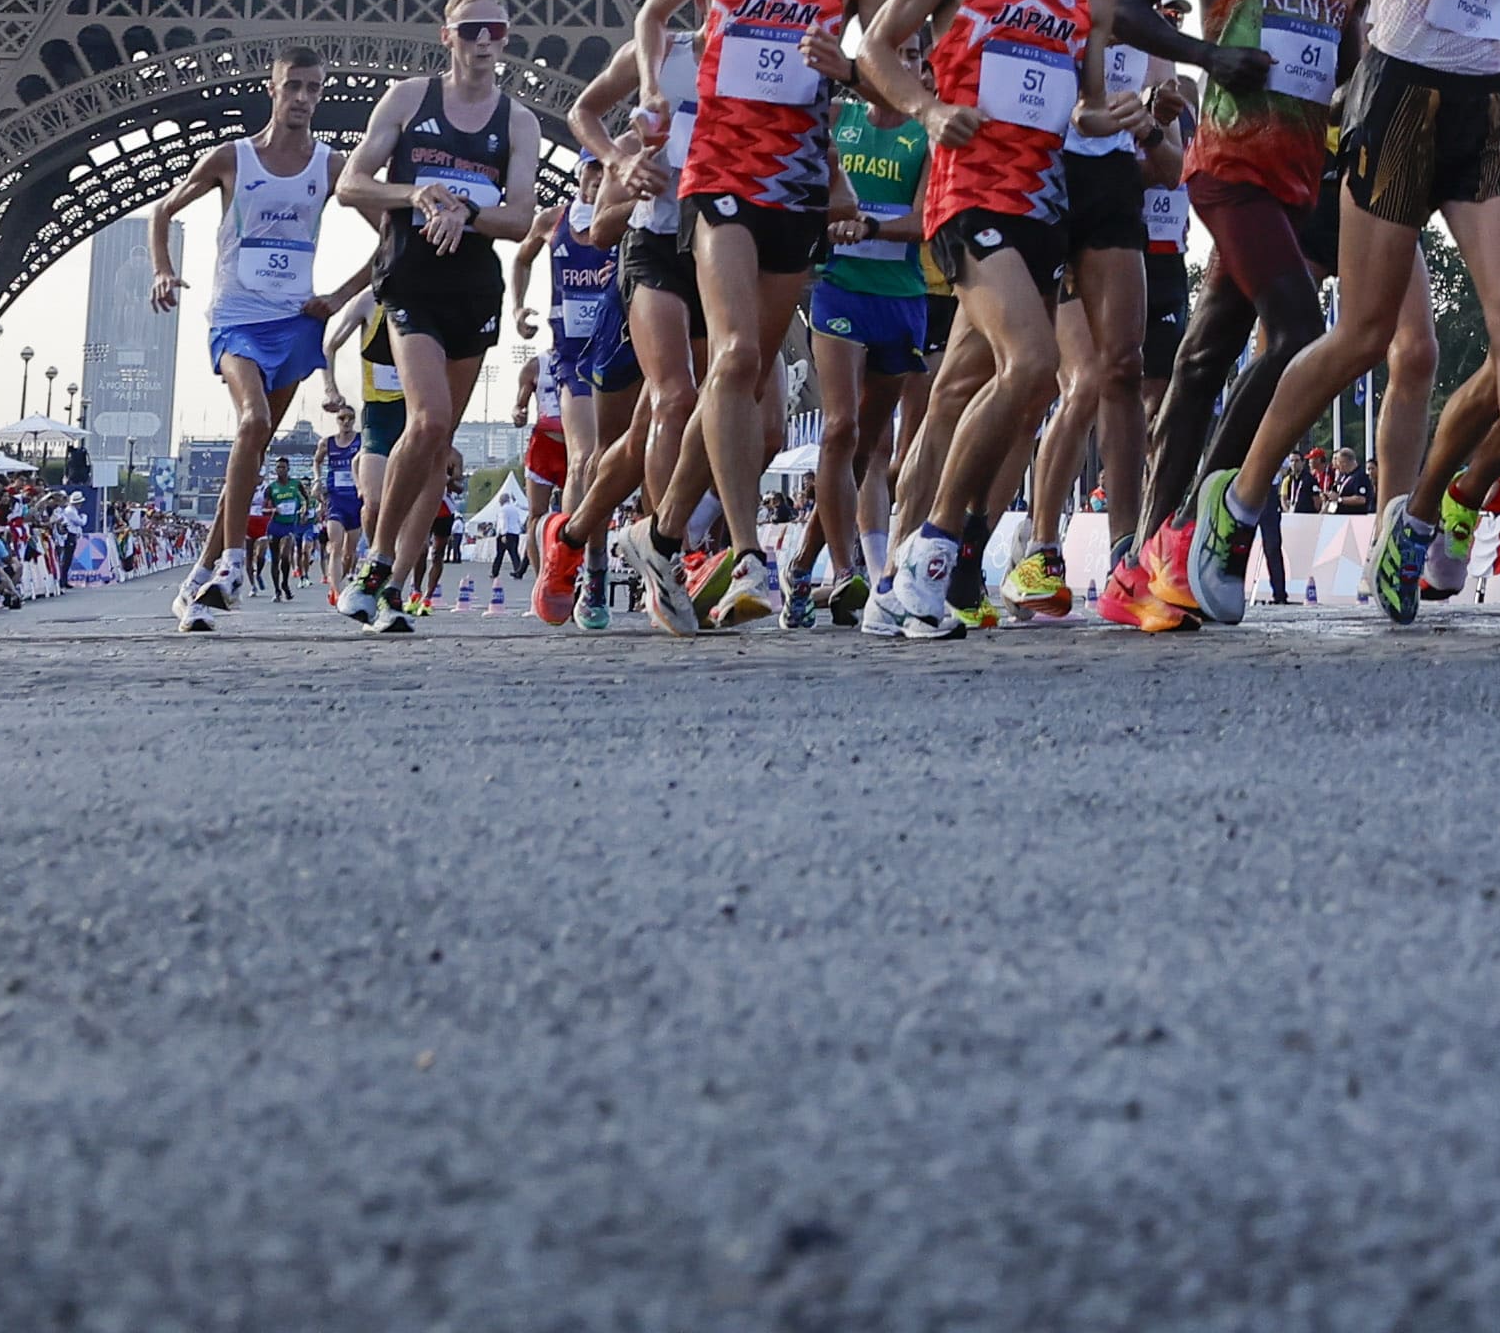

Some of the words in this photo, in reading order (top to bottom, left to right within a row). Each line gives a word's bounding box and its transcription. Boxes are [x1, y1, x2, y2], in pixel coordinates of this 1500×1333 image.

[990, 3, 1076, 41] JAPAN
[758, 47, 786, 70] 59
[1301, 44, 1322, 68] 61
[1022, 68, 1046, 94] 57
[842, 153, 903, 182] BRASIL
[1152, 195, 1171, 214] 68
[260, 211, 298, 222] ITALIA
[268, 253, 289, 270] 53
